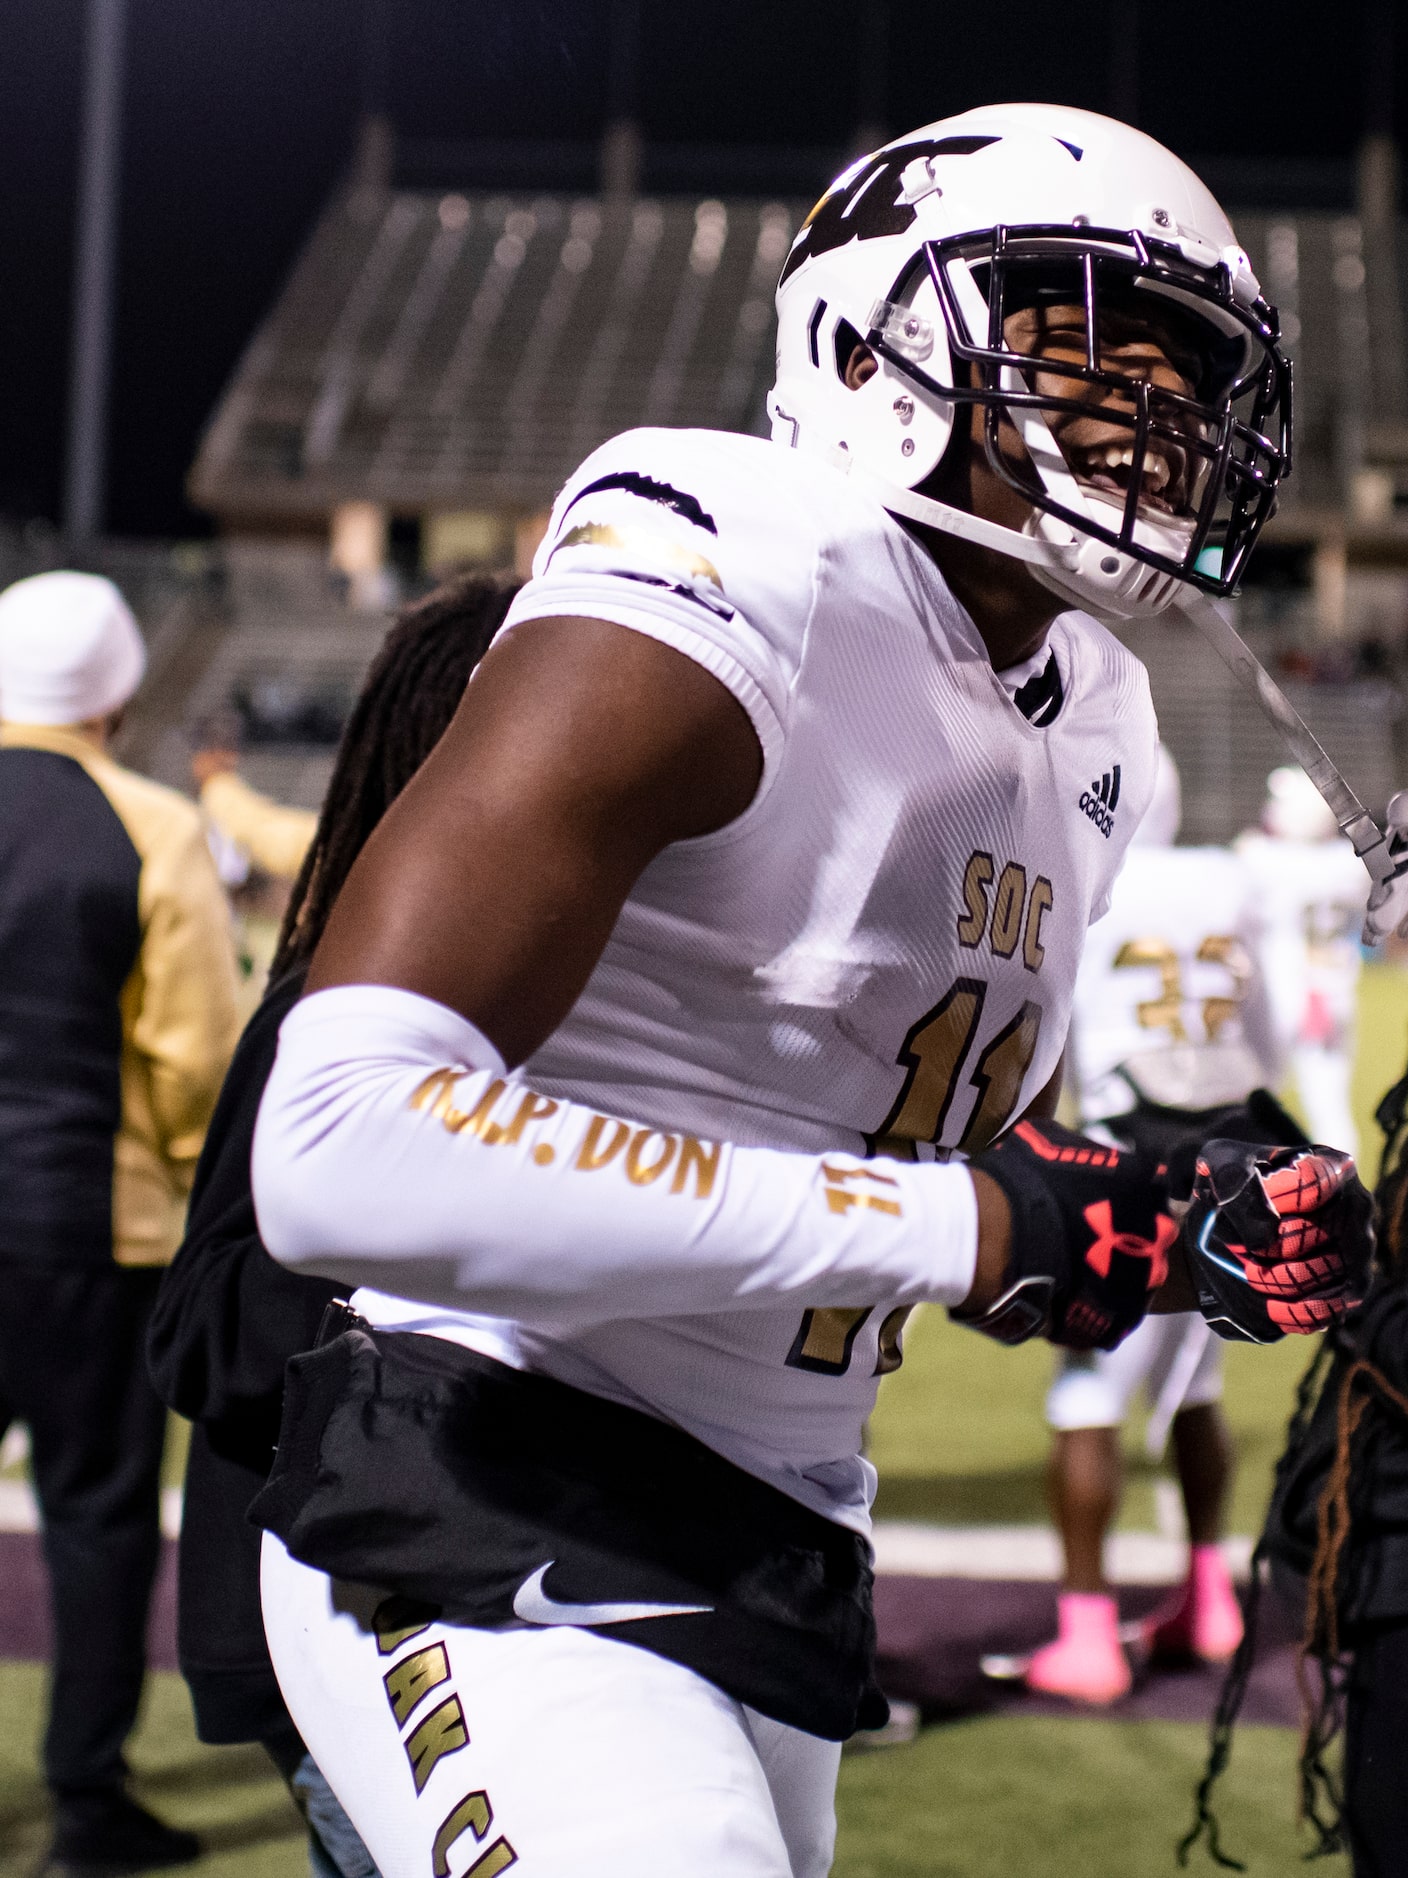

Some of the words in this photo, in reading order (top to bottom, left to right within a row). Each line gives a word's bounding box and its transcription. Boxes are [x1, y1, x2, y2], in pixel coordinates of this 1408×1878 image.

[1079, 791, 1115, 839] adidas
[956, 849, 1053, 974] SOC
[574, 1114, 722, 1200] DON
[821, 1160, 902, 1217] 11
[431, 1790, 519, 1878] C
